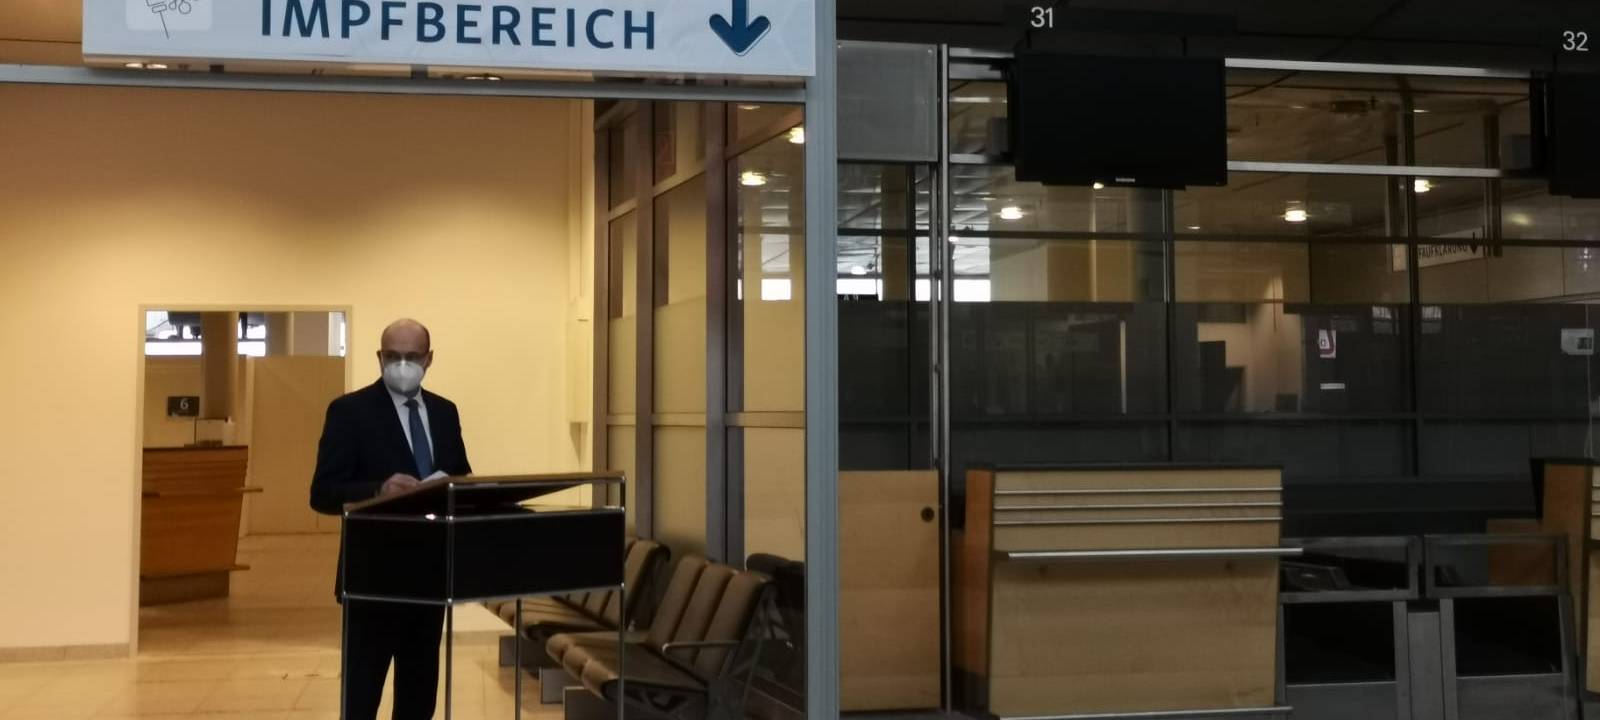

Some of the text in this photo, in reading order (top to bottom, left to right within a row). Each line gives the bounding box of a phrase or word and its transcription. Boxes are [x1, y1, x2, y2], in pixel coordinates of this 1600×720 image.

[261, 0, 656, 50] IMPFBEREICH
[1031, 6, 1053, 28] 31
[1562, 30, 1589, 51] 32
[180, 398, 189, 410] 6
